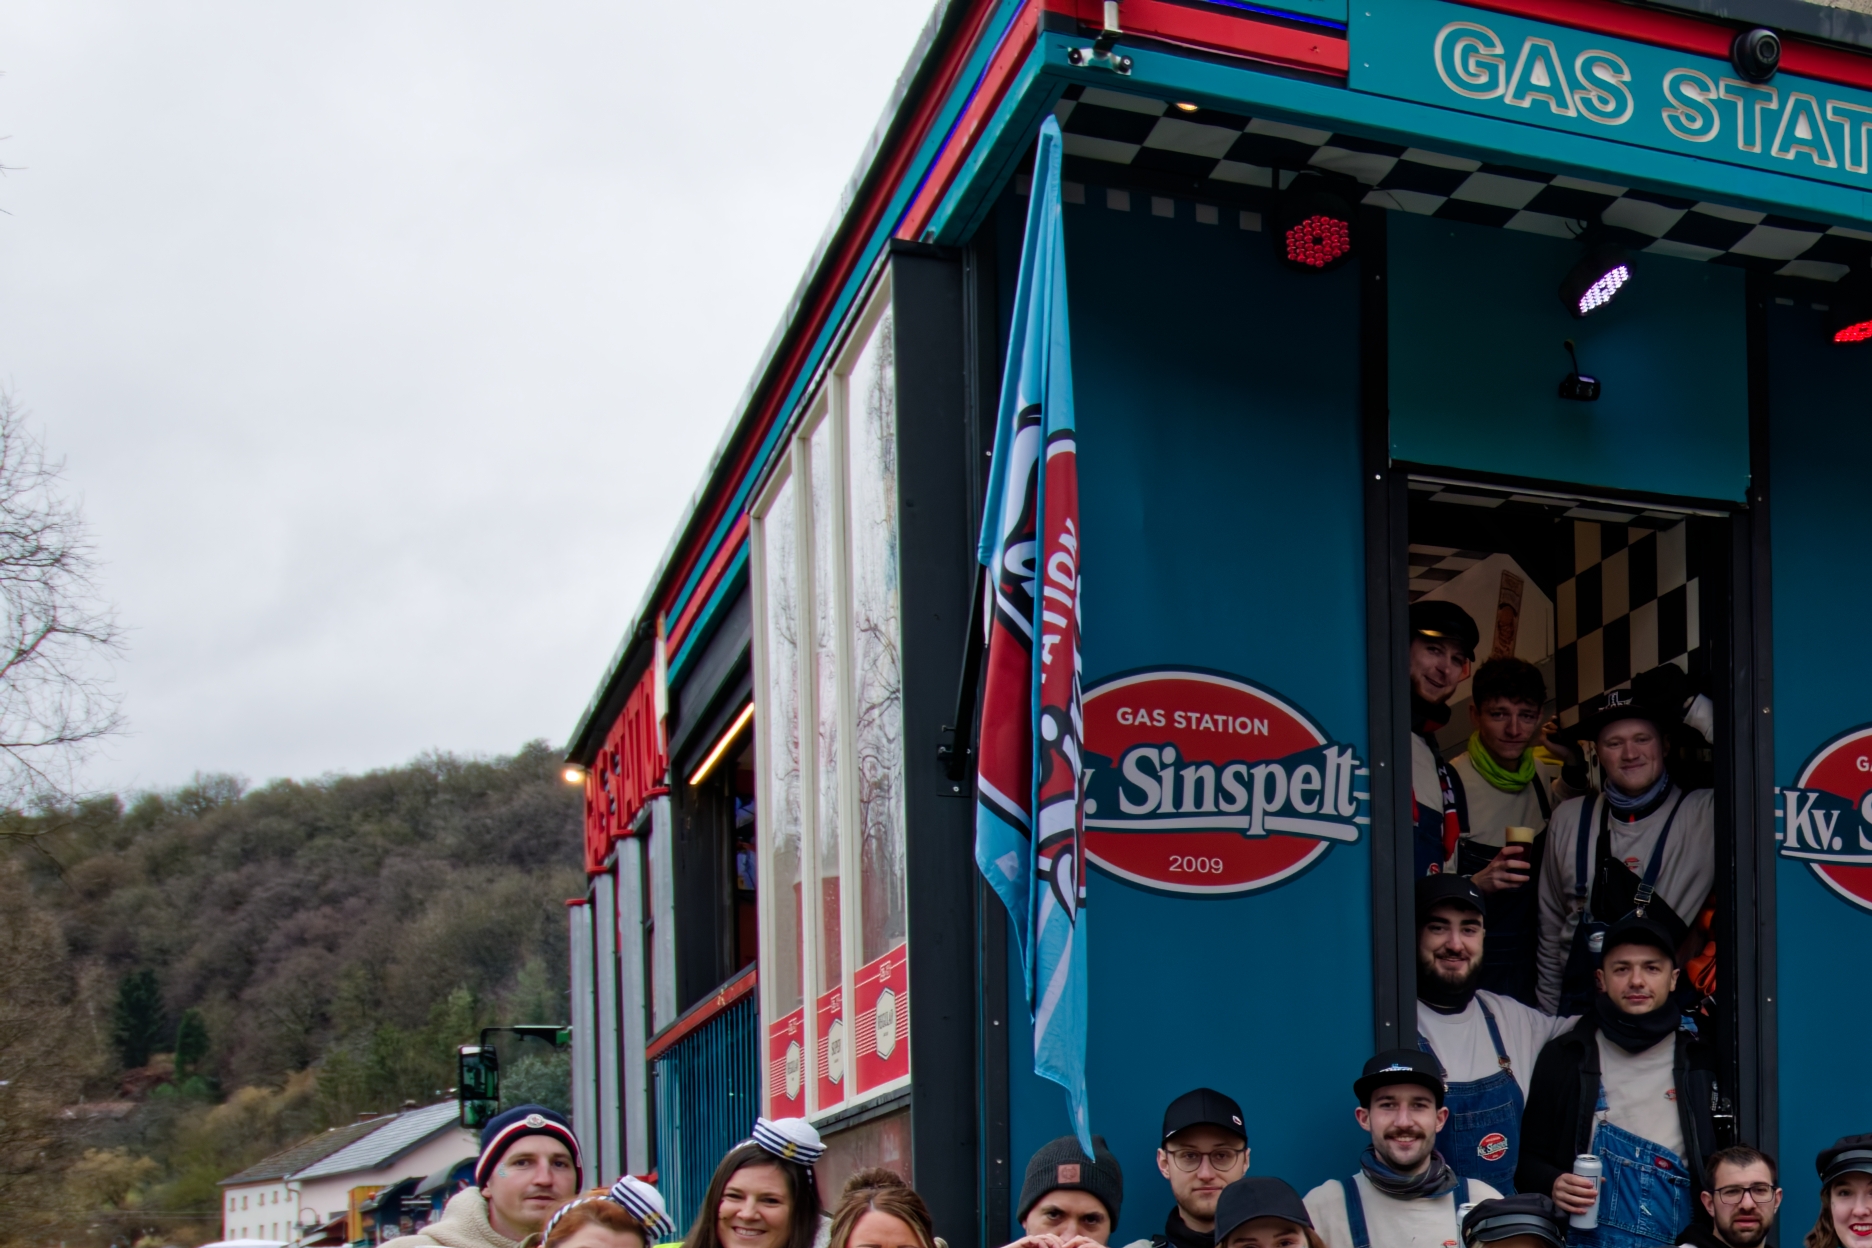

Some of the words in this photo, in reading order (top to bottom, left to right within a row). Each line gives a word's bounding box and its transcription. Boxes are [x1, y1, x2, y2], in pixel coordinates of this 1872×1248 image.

[1433, 21, 1635, 126] GAS
[1116, 707, 1166, 727] GAS
[1174, 711, 1269, 736] STATION
[1119, 745, 1361, 836] Sinspelt
[1783, 790, 1843, 851] Kv.
[1168, 855, 1224, 874] 2009
